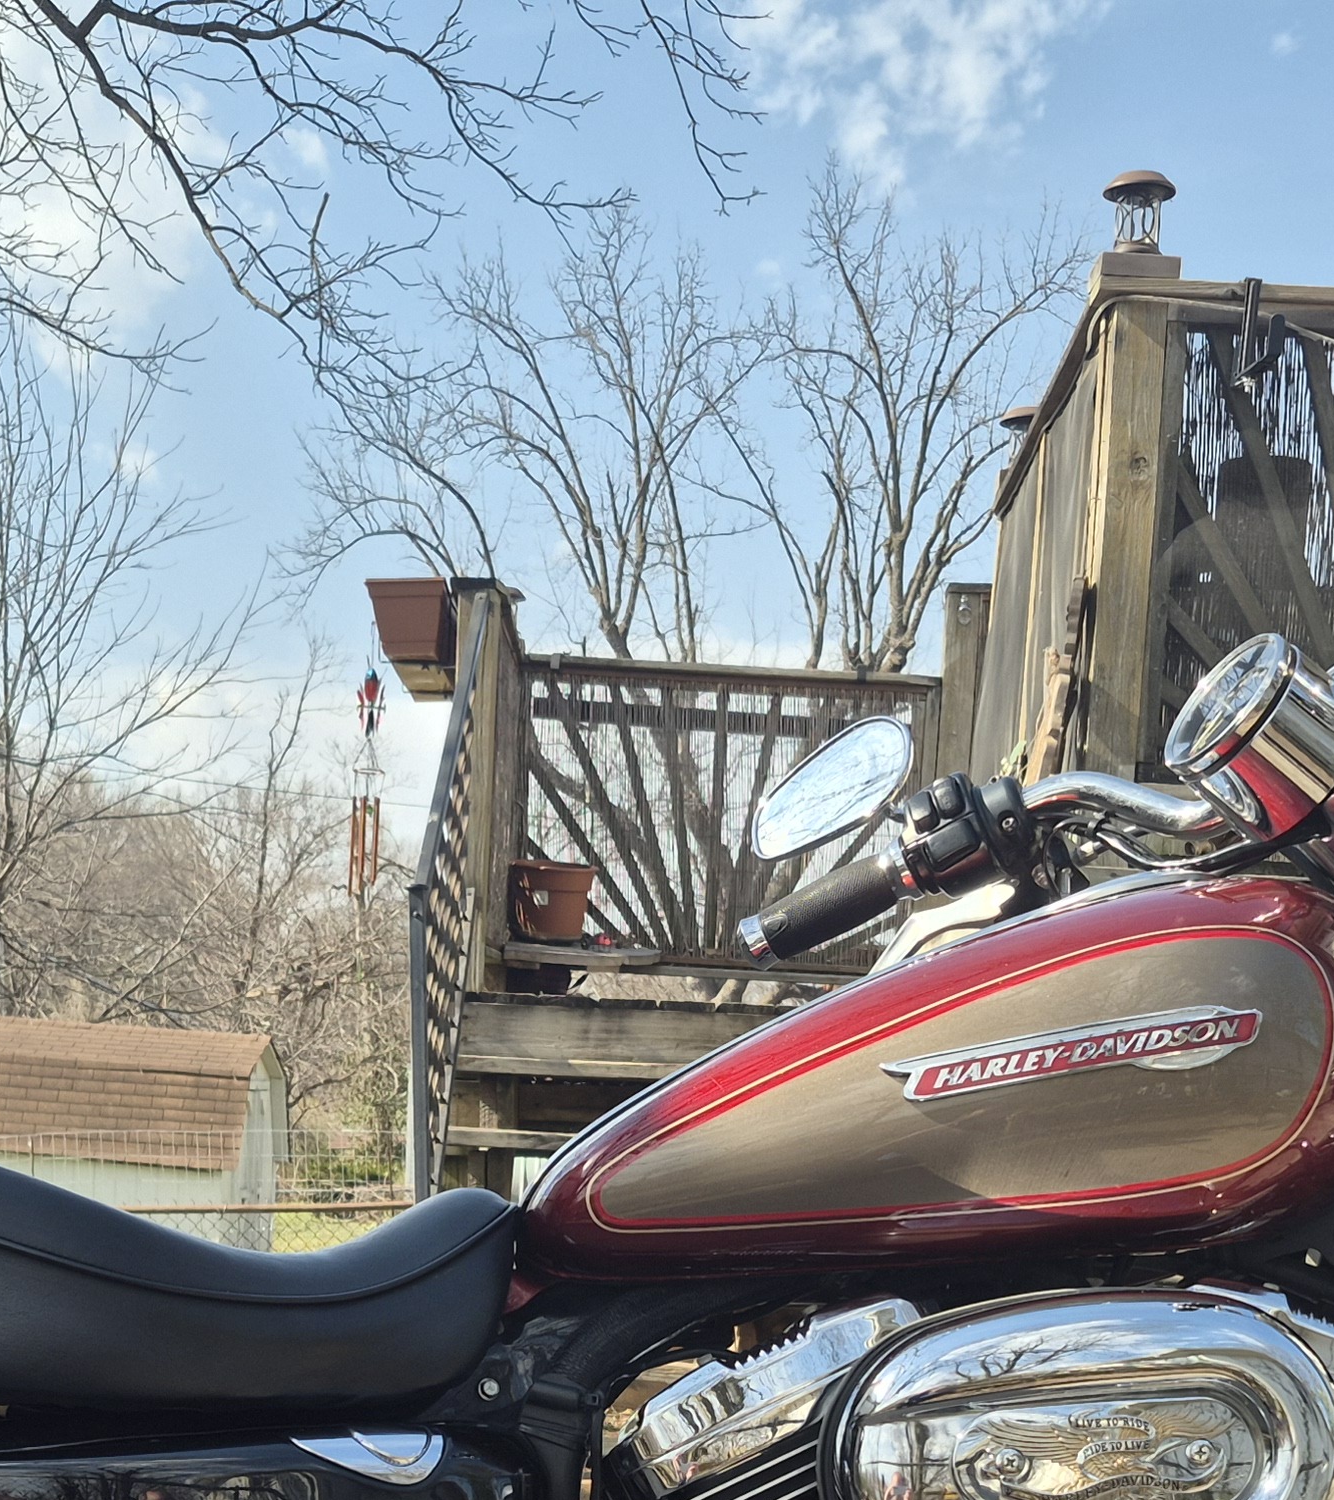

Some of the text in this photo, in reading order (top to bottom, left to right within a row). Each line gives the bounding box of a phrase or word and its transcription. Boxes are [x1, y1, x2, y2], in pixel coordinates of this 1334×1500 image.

[932, 1018, 1239, 1089] HARLEY-DAVIDSON
[1074, 1416, 1151, 1432] LIVE TO RIDE
[1082, 1440, 1150, 1459] RIDE TO LIVE
